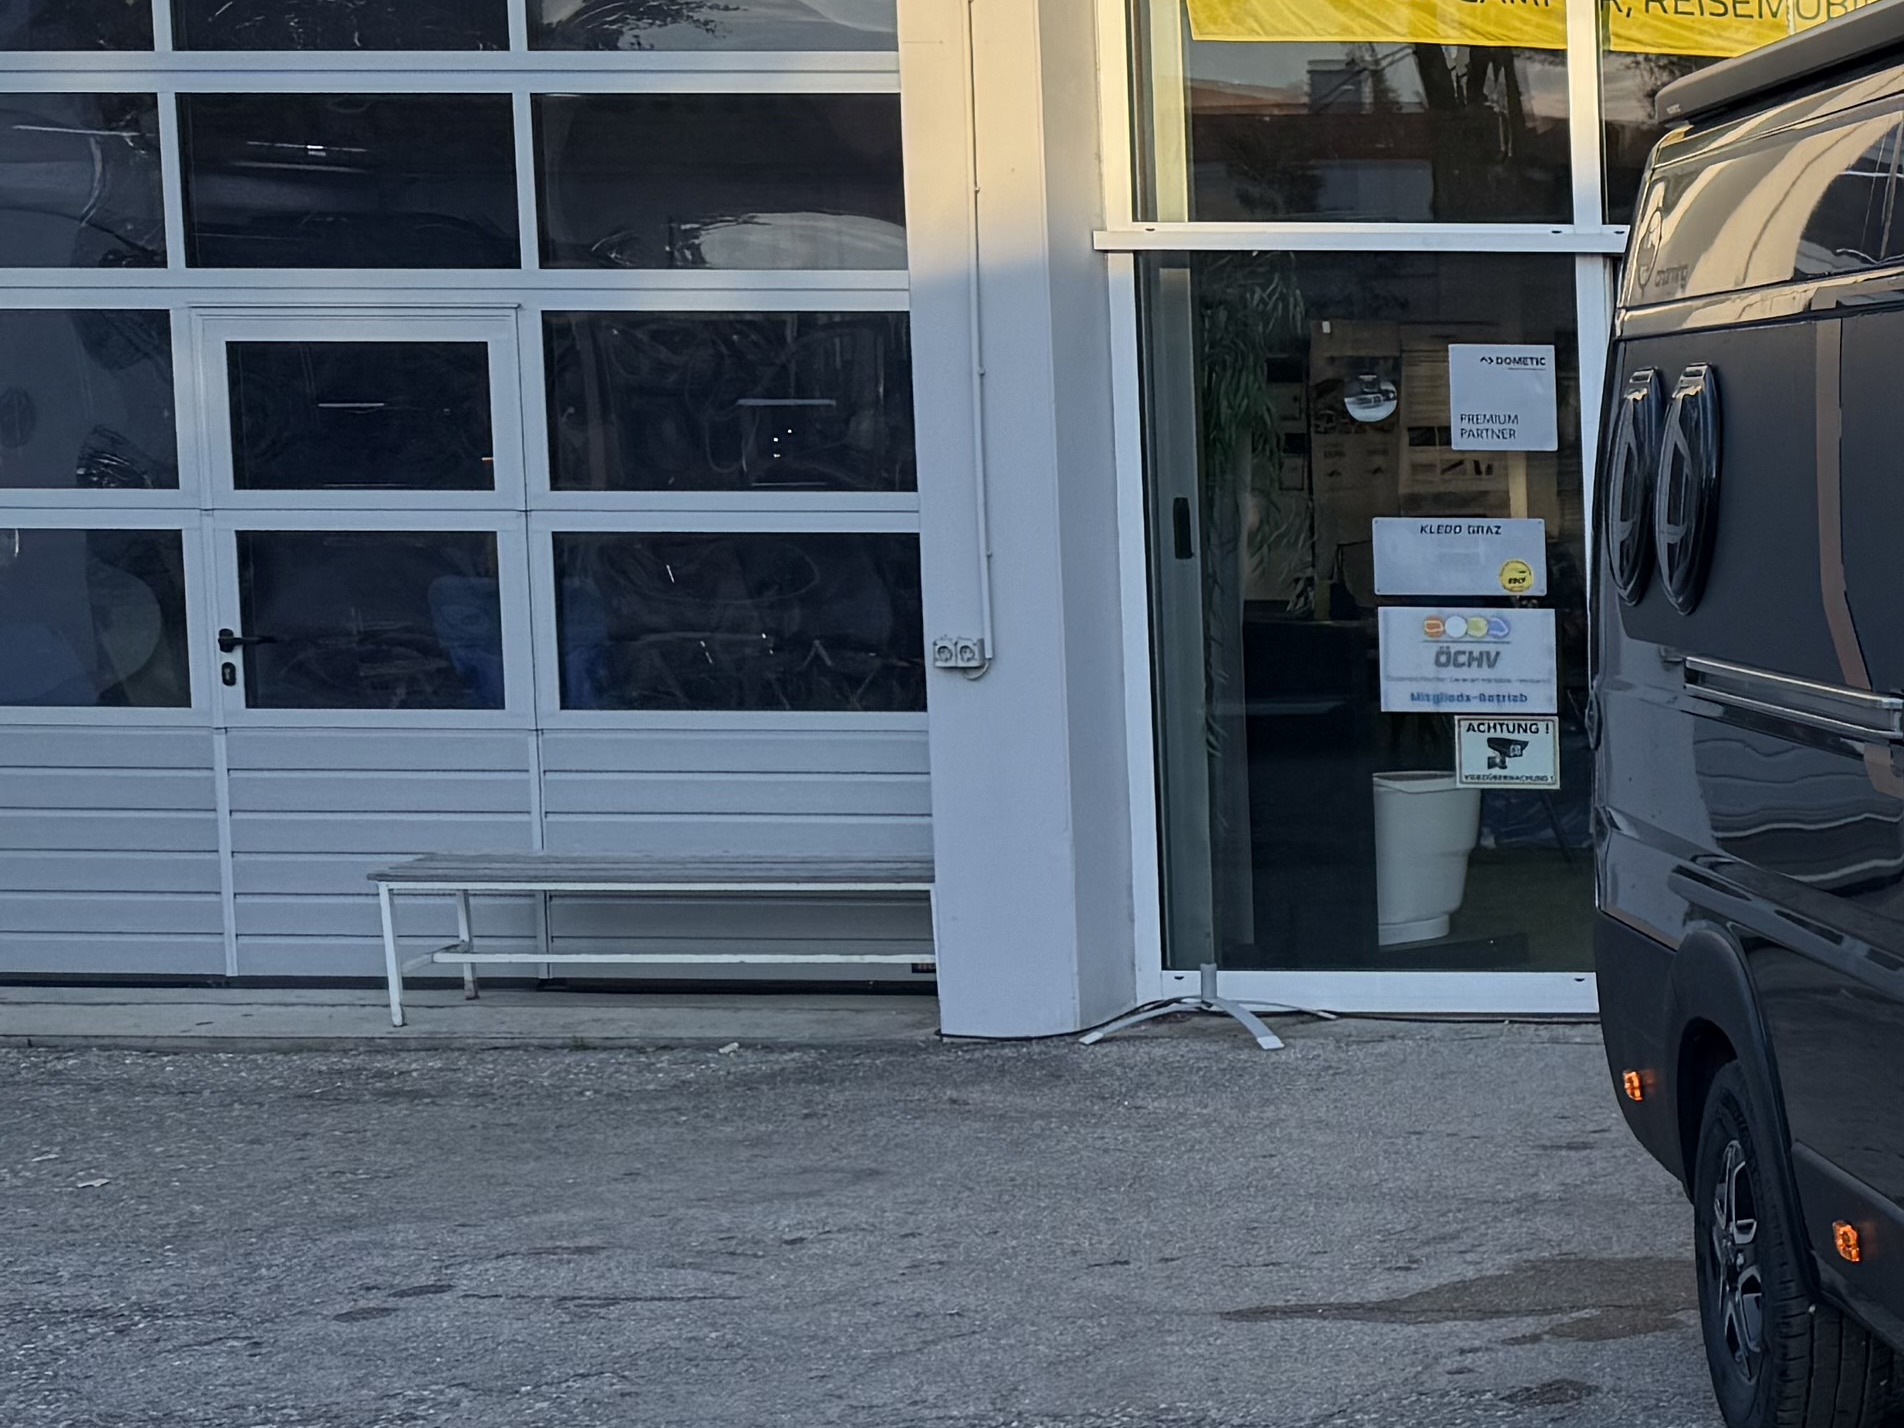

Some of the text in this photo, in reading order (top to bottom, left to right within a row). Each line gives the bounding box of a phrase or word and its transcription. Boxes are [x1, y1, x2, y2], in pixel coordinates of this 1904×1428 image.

[1495, 356, 1547, 367] DOMETIC
[1460, 413, 1519, 425] PREMIUM
[1460, 427, 1517, 440] PARTNER
[1420, 524, 1502, 536] KLEDO GRAZ
[1434, 646, 1501, 669] ÖCHV
[1466, 722, 1540, 735] ACHTUNG
